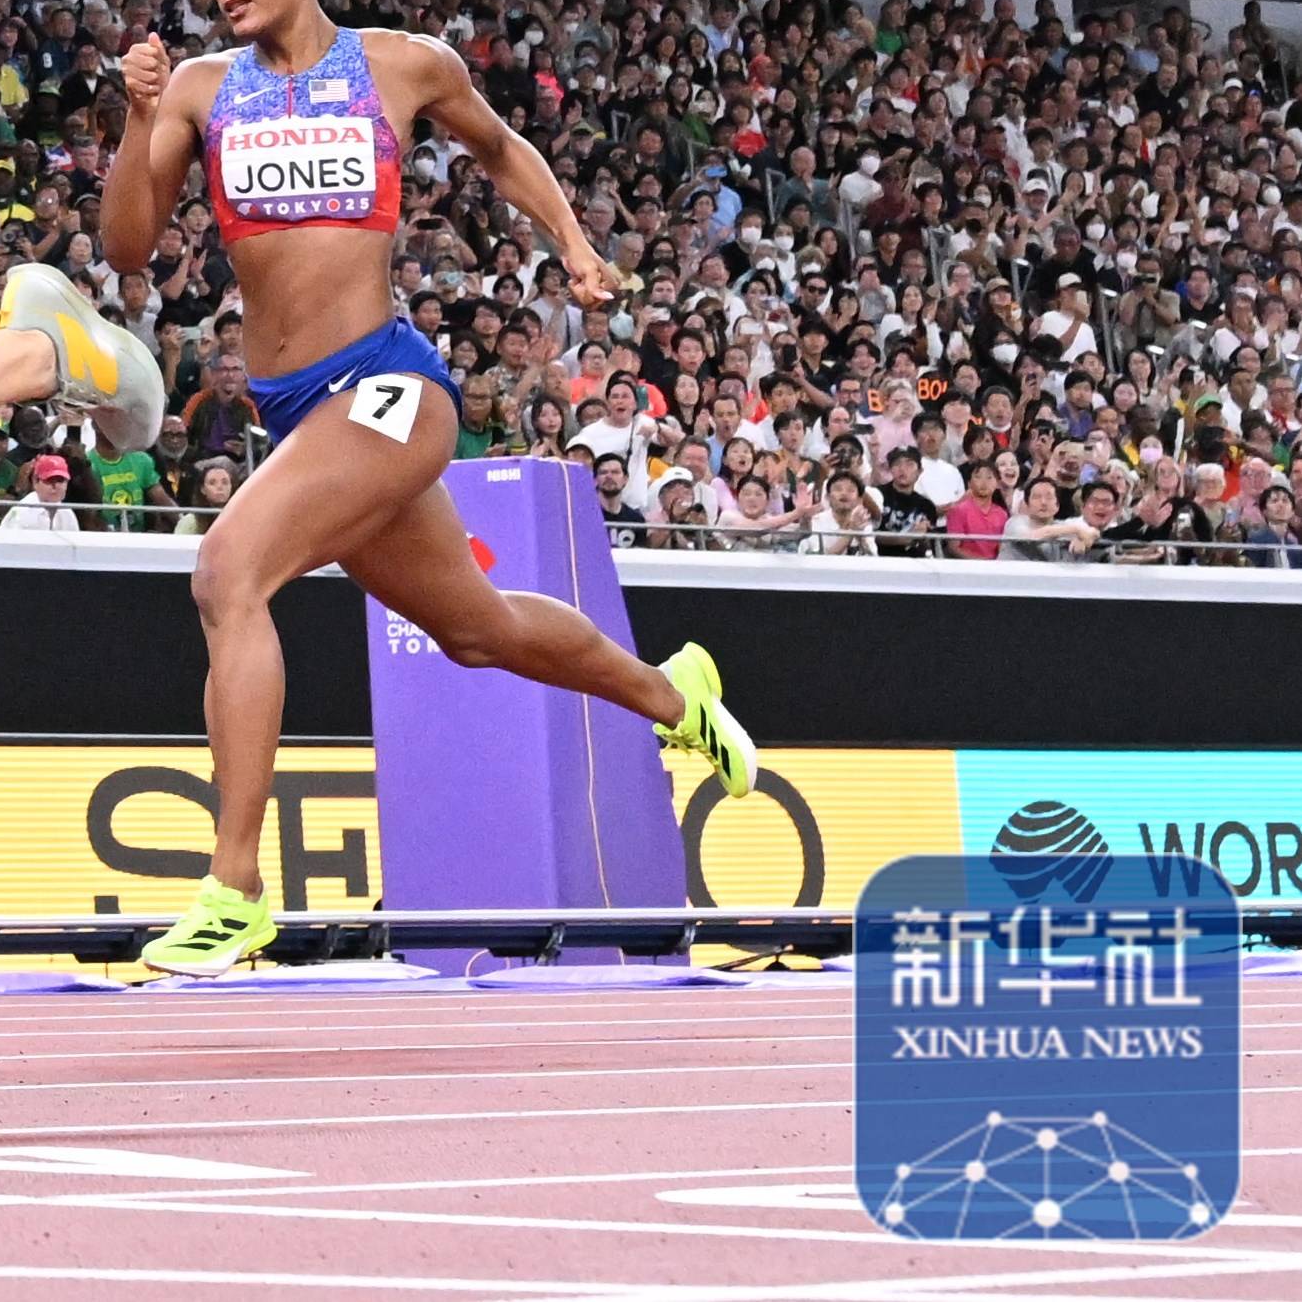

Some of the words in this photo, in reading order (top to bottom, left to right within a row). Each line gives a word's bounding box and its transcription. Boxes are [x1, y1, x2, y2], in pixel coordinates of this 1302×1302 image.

[225, 126, 369, 151] HONDA
[234, 157, 366, 194] JONES
[371, 384, 405, 420] 7
[486, 467, 522, 483] NISHI
